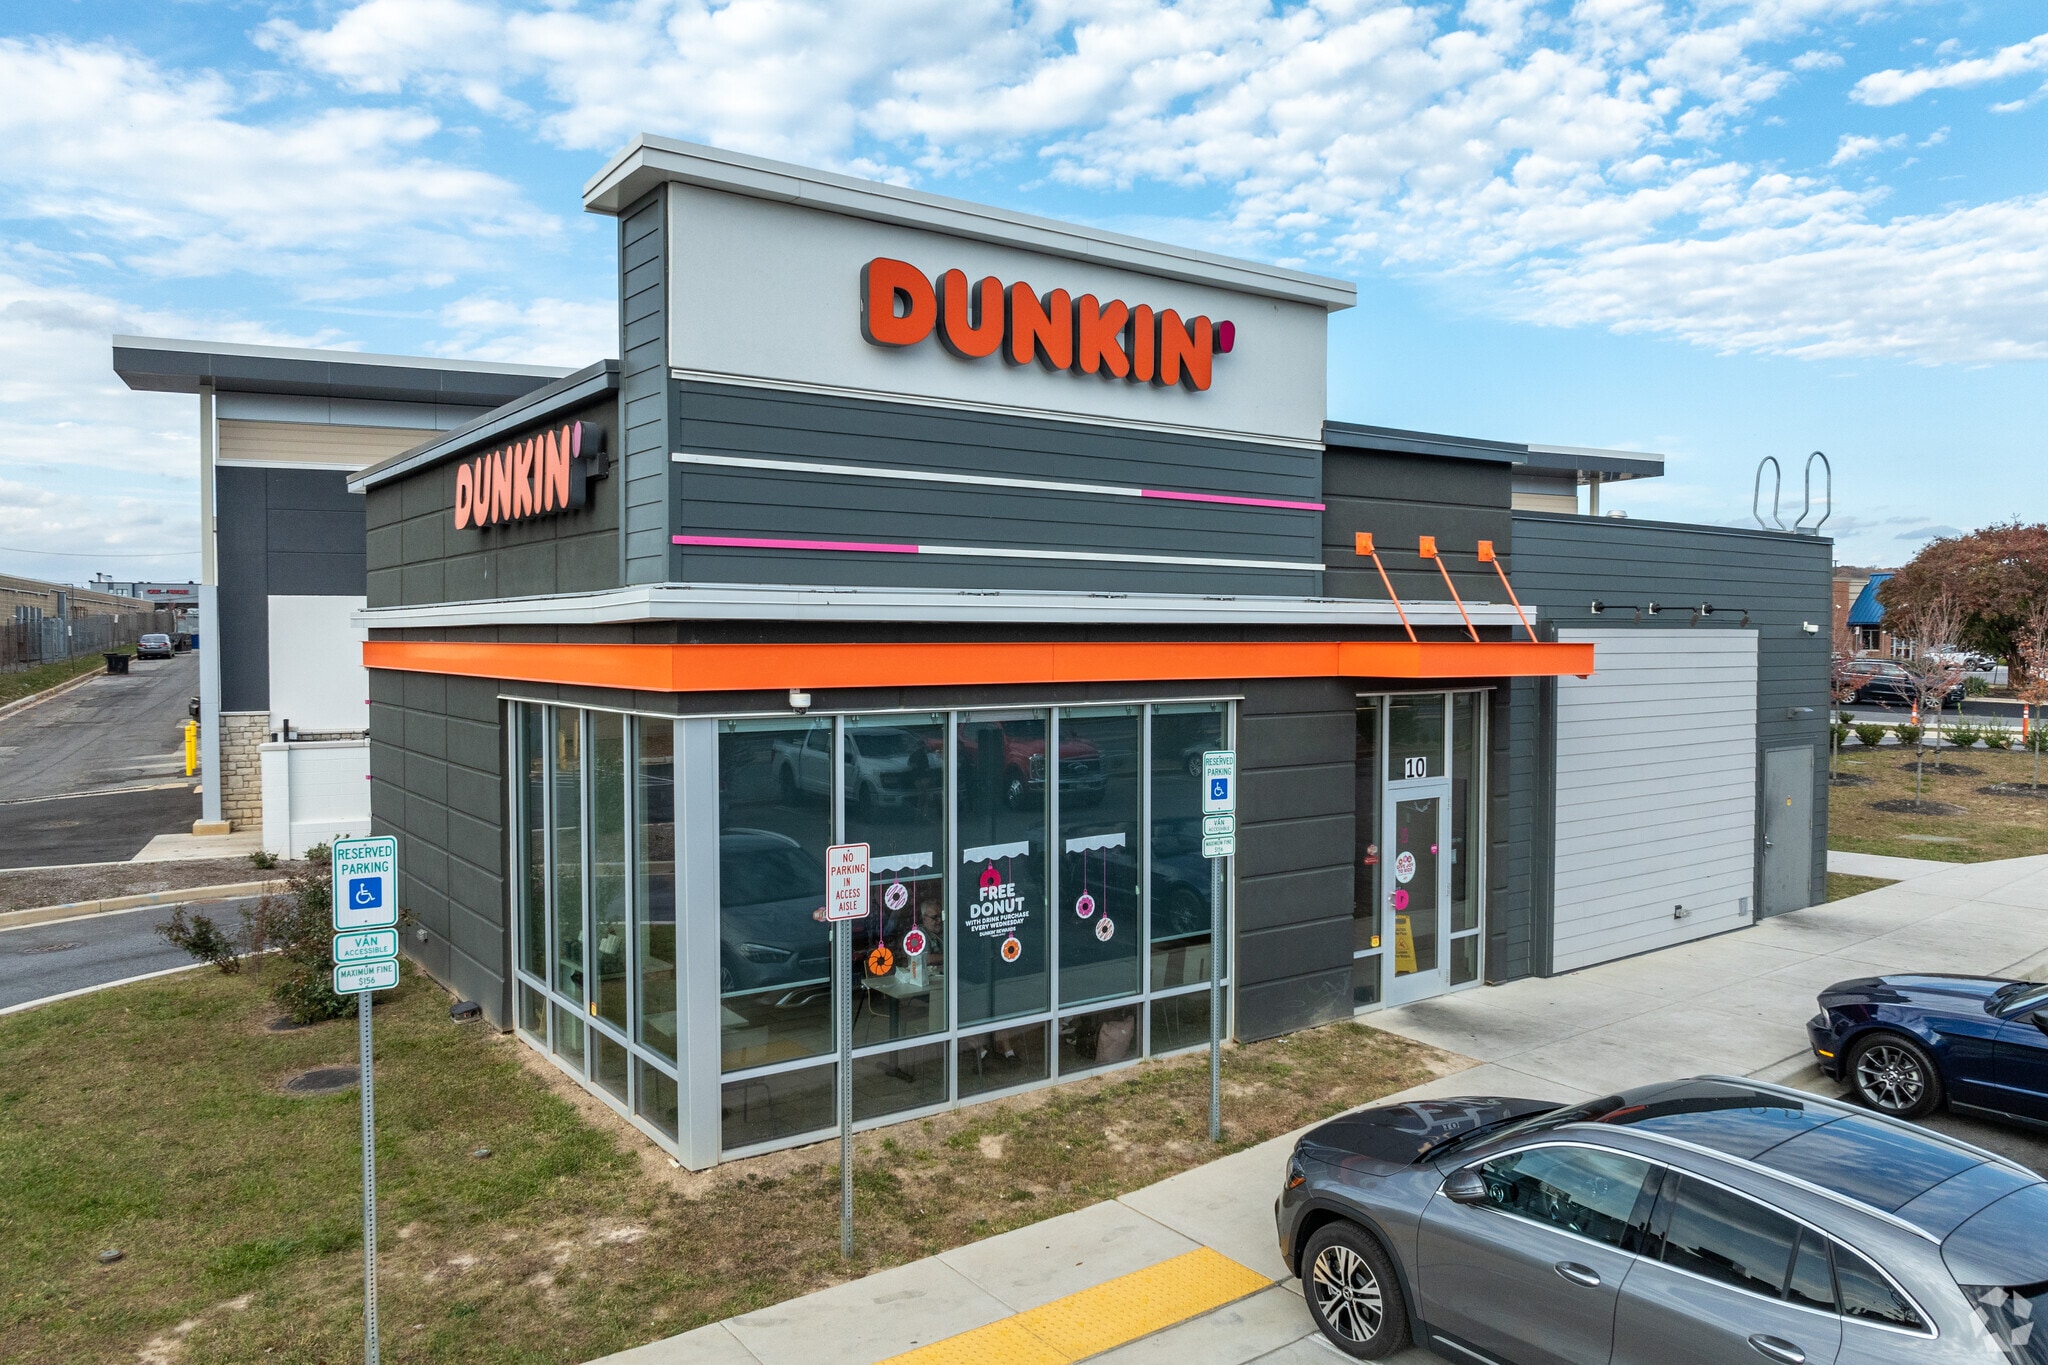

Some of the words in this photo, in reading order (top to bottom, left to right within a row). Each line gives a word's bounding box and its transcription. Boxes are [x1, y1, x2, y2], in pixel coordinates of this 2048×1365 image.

[861, 257, 1235, 391] DUNKIN'
[455, 420, 582, 530] DUNKIN'
[1205, 757, 1233, 766] RESERVED
[1406, 757, 1425, 778] 10
[1207, 767, 1231, 776] PARKING
[337, 845, 392, 861] RESERVED
[842, 853, 854, 863] NO
[341, 861, 389, 875] PARKING
[831, 864, 865, 876] PARKING
[843, 877, 851, 887] IN
[835, 888, 861, 900] ACCESS
[979, 882, 1016, 902] FREE
[838, 900, 857, 912] AISLE
[970, 897, 1025, 919] DONUT
[965, 918, 981, 927] WITH
[981, 915, 1000, 924] DRINK
[1000, 910, 1030, 921] PURCHASE
[971, 924, 990, 932] EVERY
[990, 918, 1025, 929] WEDNESDAY
[354, 936, 378, 947] VAN
[344, 946, 389, 956] ACCESSIBLE
[340, 967, 375, 978] MAXIMUM
[376, 964, 393, 974] FINE
[358, 977, 376, 986] $156
